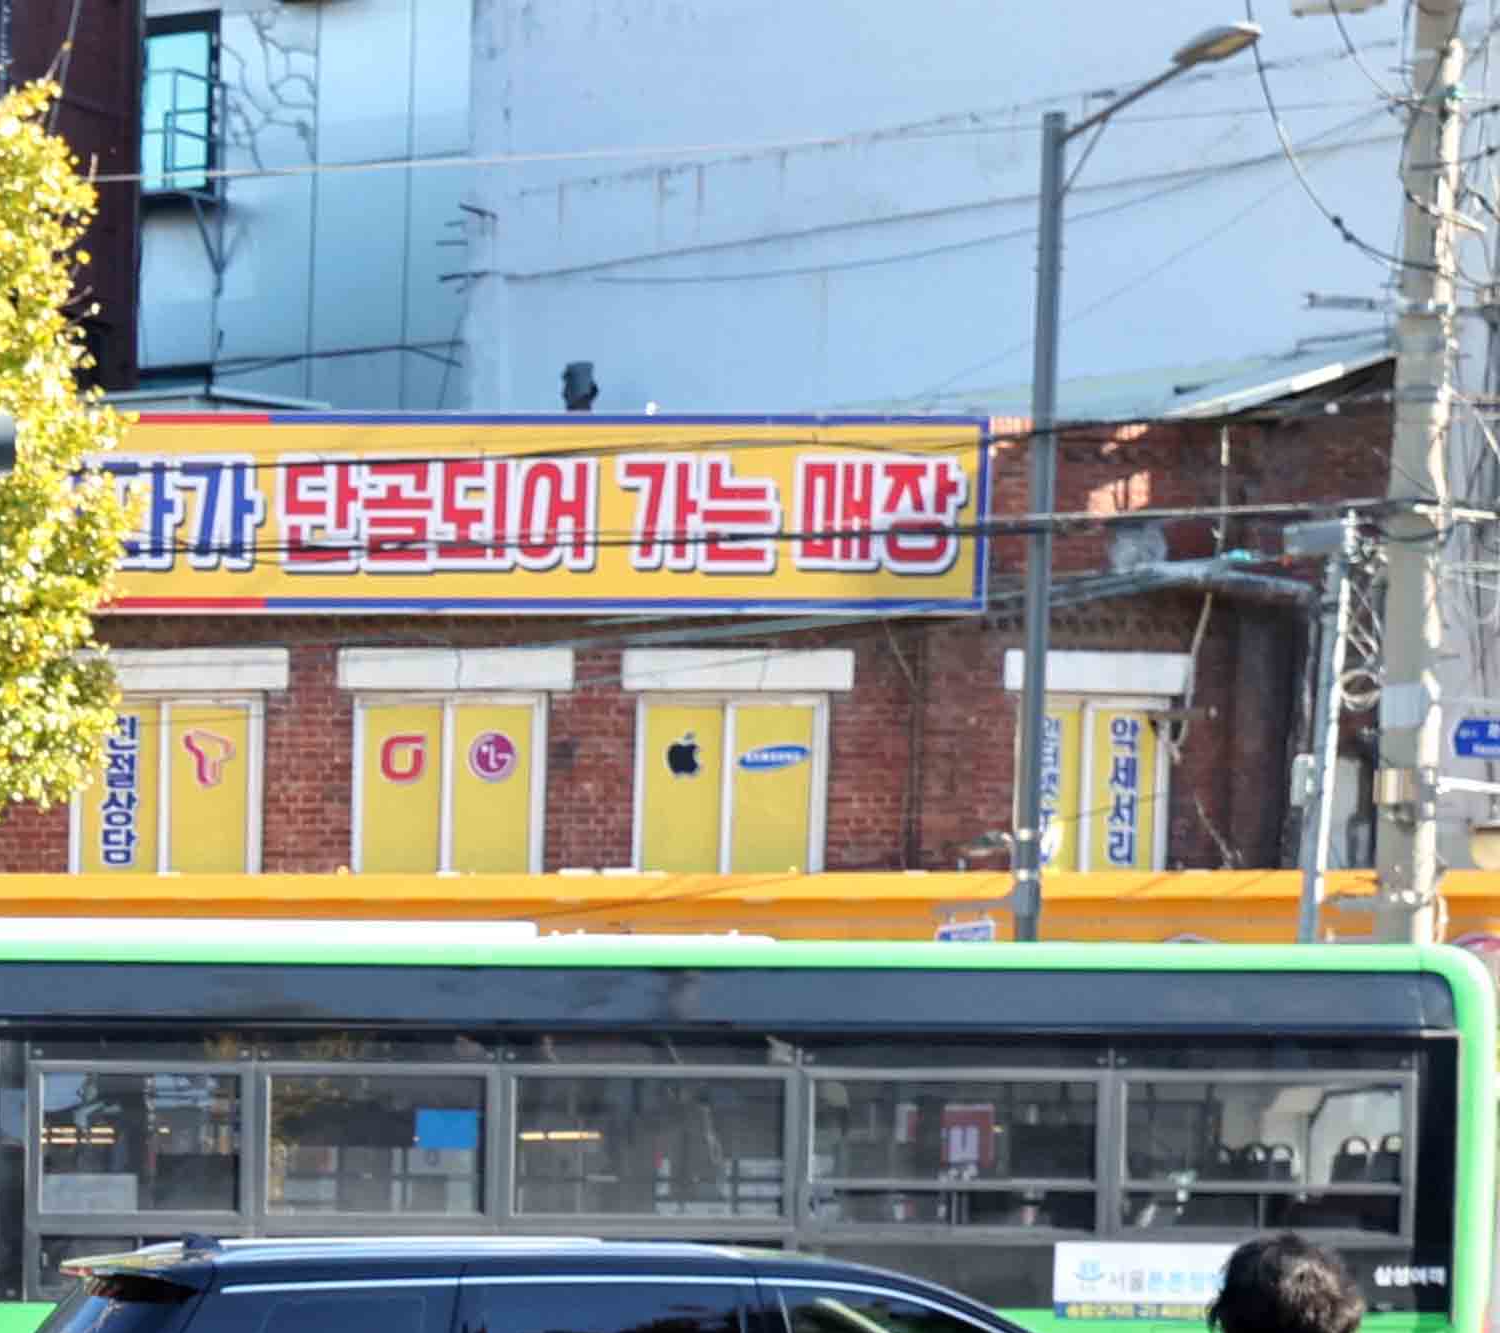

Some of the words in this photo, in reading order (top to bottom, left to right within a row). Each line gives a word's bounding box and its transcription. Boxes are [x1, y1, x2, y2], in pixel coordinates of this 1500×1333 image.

[283, 455, 592, 565] 단골되어
[622, 458, 774, 566] 가는
[803, 458, 960, 566] 매장
[1108, 718, 1142, 865] 악세서리
